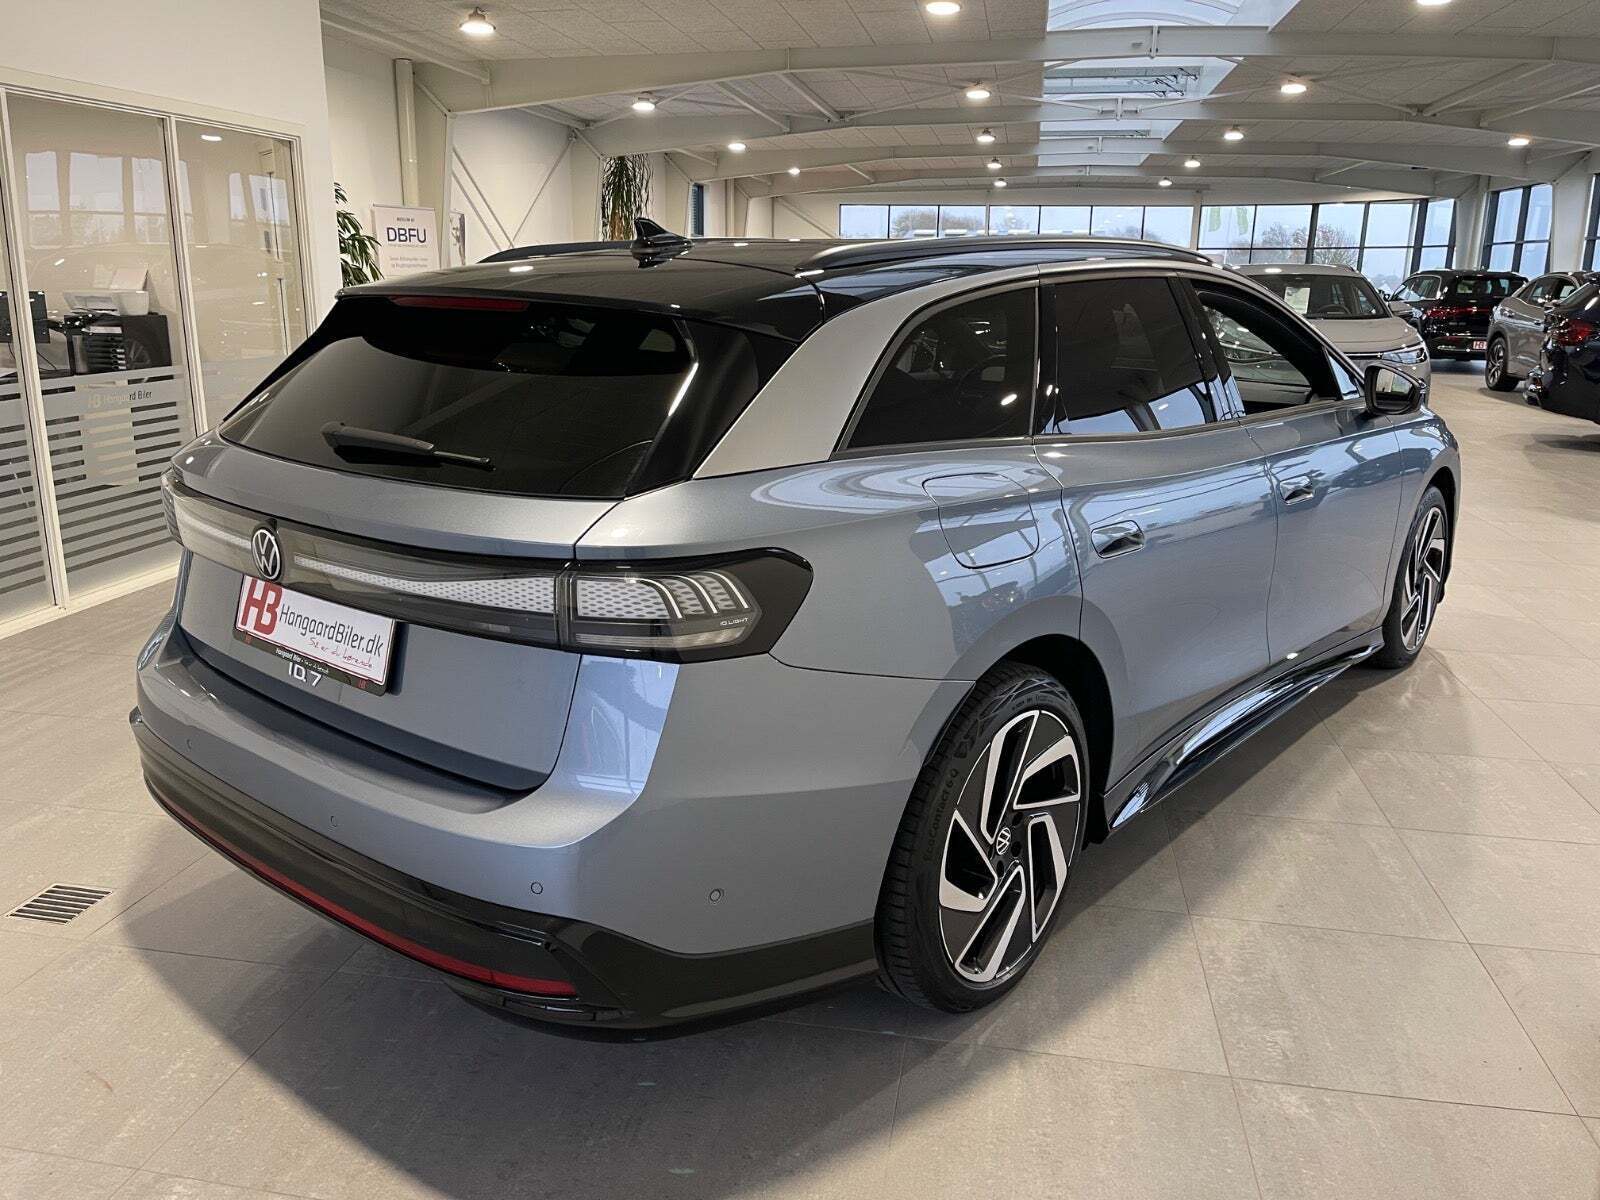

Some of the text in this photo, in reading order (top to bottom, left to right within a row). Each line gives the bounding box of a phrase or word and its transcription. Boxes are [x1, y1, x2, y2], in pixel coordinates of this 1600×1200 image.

[387, 227, 426, 243] DBFU
[241, 577, 283, 635] HB
[279, 604, 384, 657] HangaardBiler.dk
